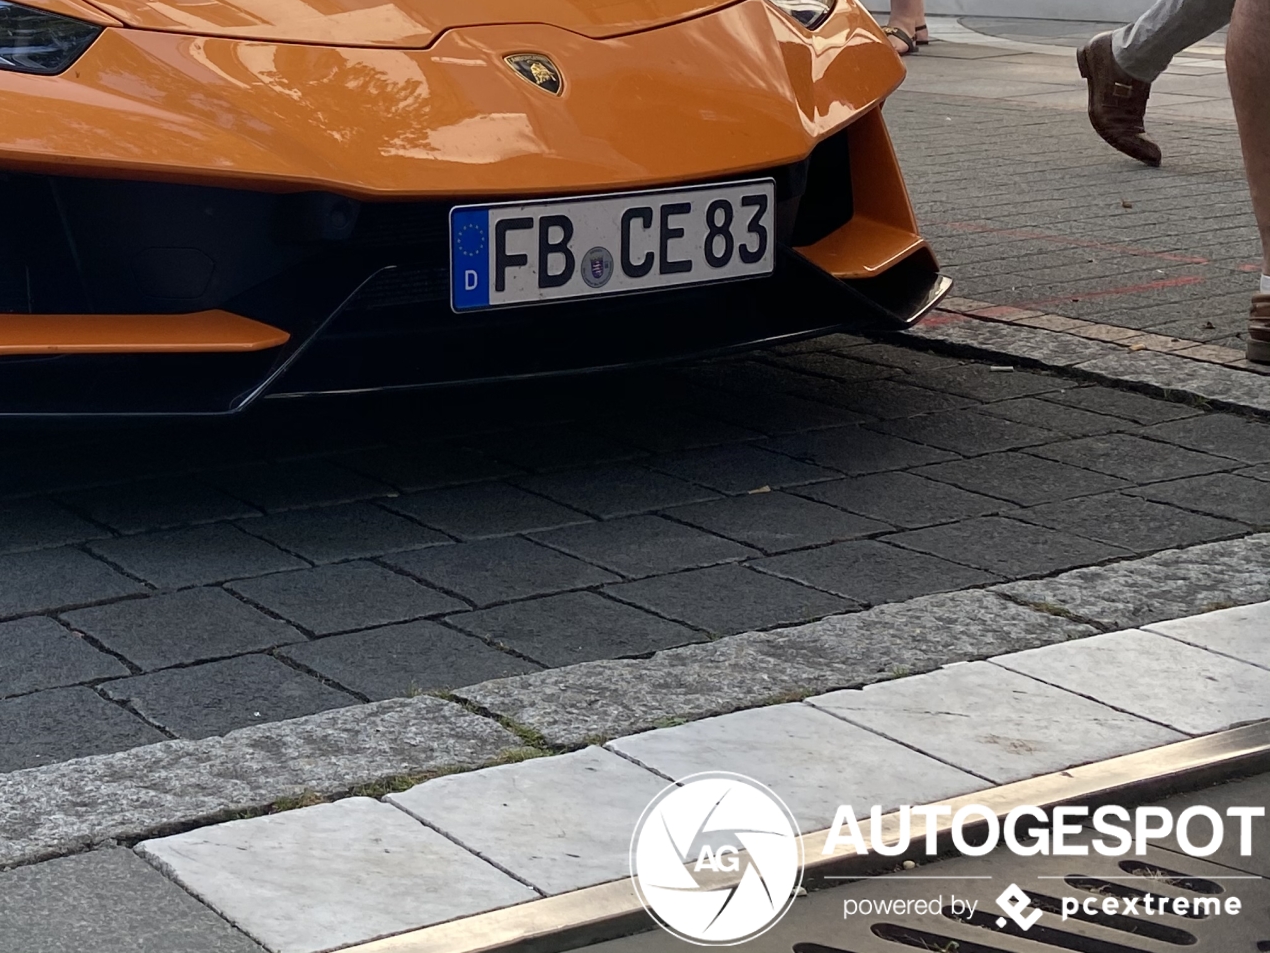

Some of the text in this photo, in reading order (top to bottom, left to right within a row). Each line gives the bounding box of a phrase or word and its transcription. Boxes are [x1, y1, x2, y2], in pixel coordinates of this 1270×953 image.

[494, 214, 576, 293] FB
[620, 202, 694, 278] CE
[703, 194, 769, 269] 83
[464, 268, 478, 292] D
